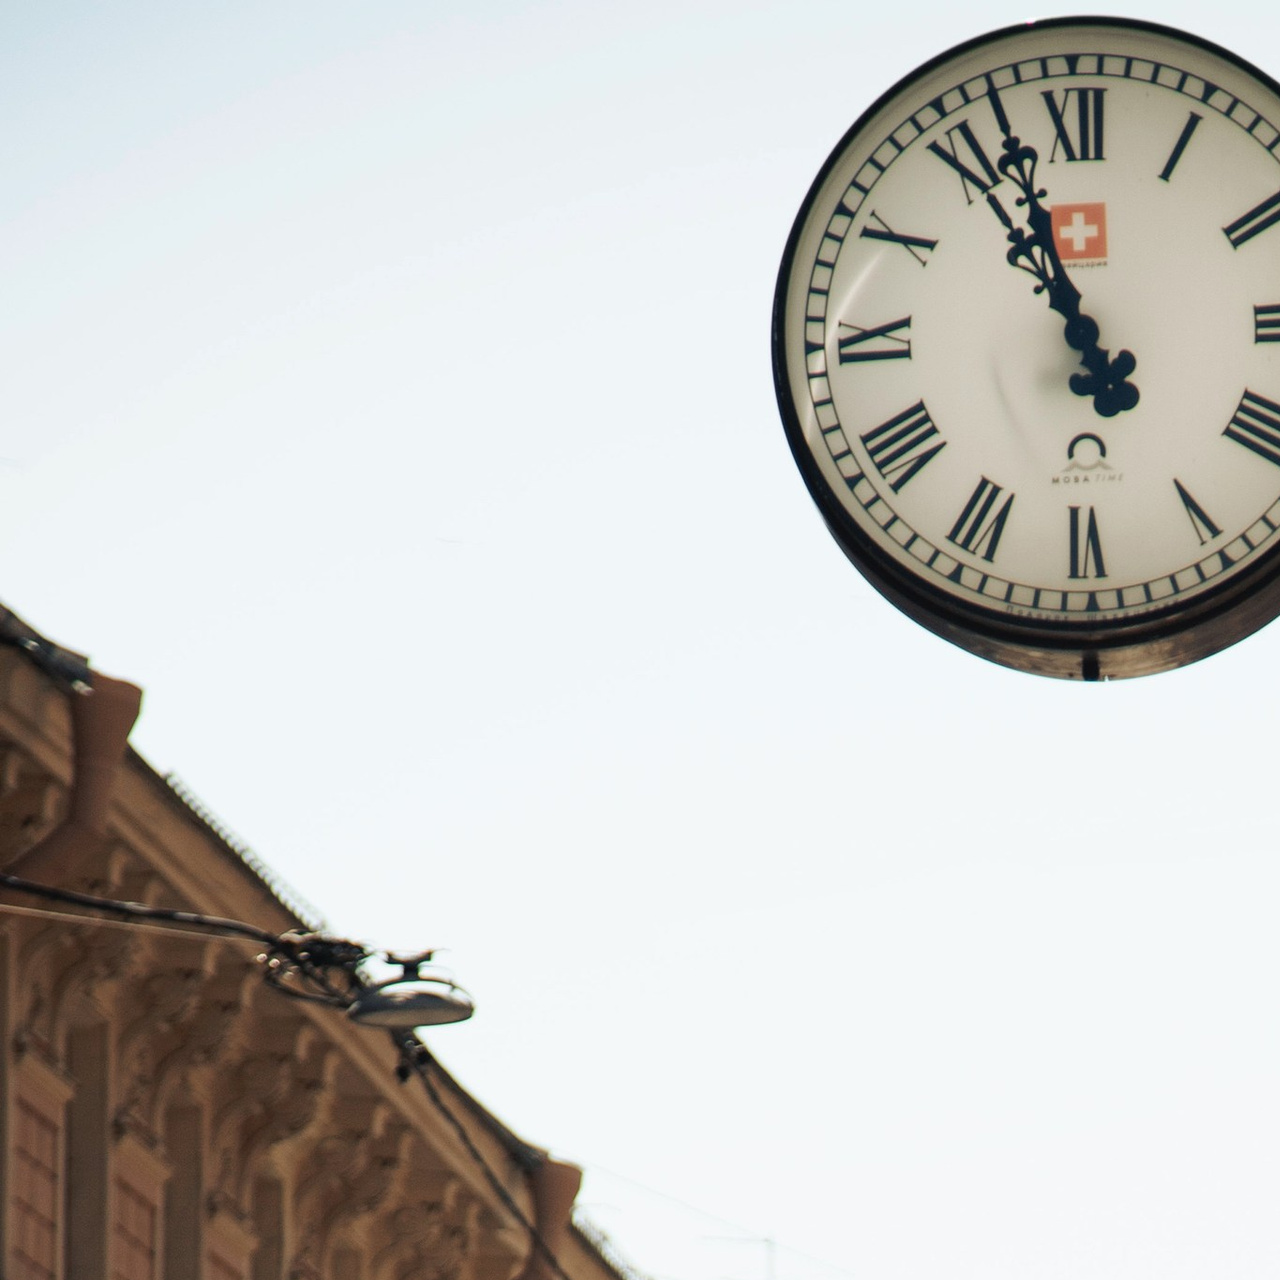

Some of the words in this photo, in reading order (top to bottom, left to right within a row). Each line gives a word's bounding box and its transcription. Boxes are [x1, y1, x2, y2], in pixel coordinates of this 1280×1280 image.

[925, 118, 1002, 205] XI
[1040, 87, 1108, 163] XII
[1158, 111, 1204, 182] I
[859, 209, 939, 267] X
[837, 315, 912, 365] IX
[859, 399, 948, 494] VIII
[945, 475, 1015, 563] VII
[1067, 505, 1108, 579] VI
[1173, 478, 1223, 546] V
